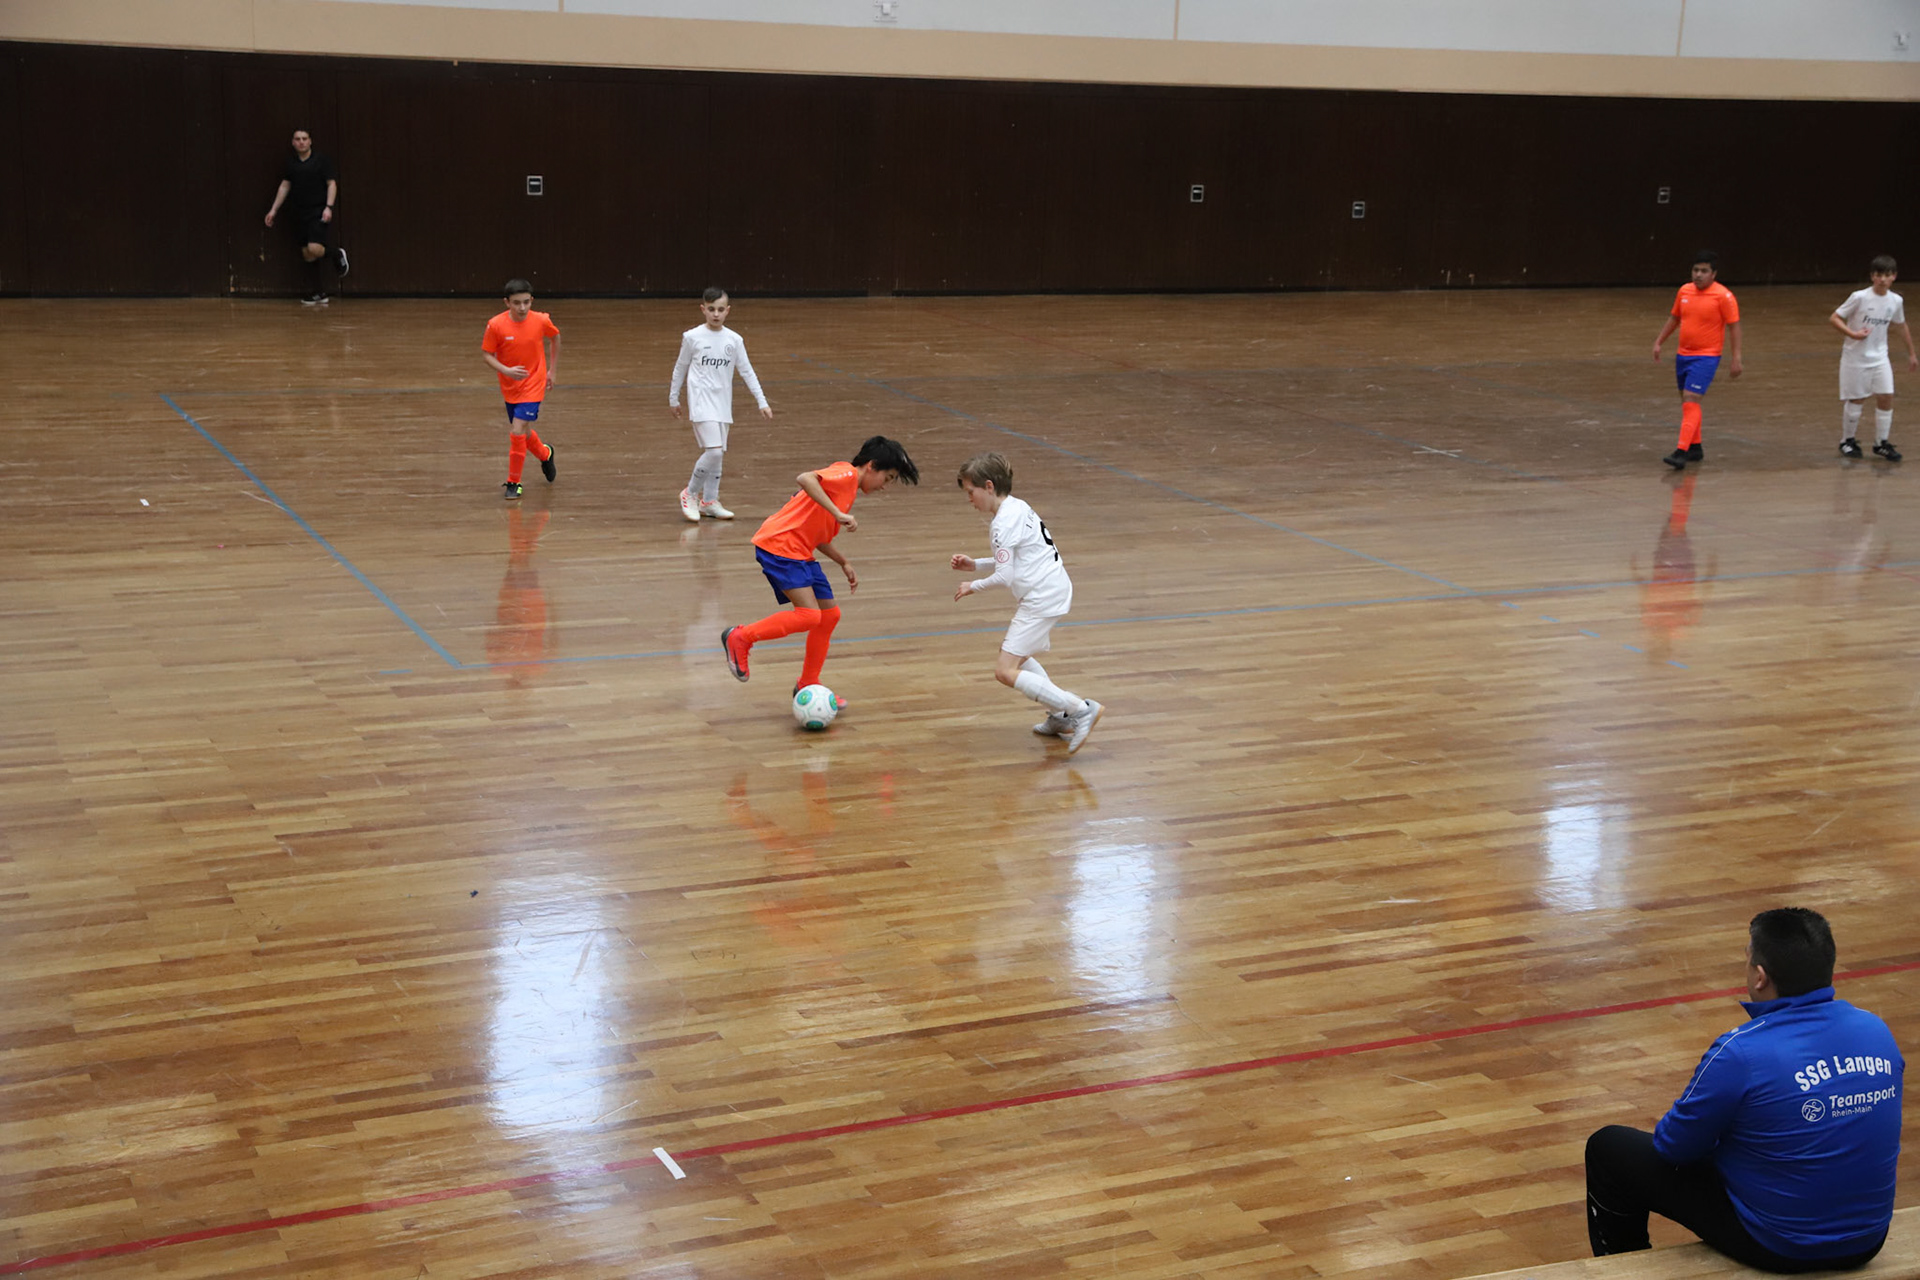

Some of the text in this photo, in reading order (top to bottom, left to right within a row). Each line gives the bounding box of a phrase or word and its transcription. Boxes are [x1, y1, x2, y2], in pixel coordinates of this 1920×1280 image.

[1794, 1055, 1892, 1092] SSG Langen
[1828, 1084, 1896, 1109] Teamsport
[1831, 1104, 1873, 1118] Rhein-Main
